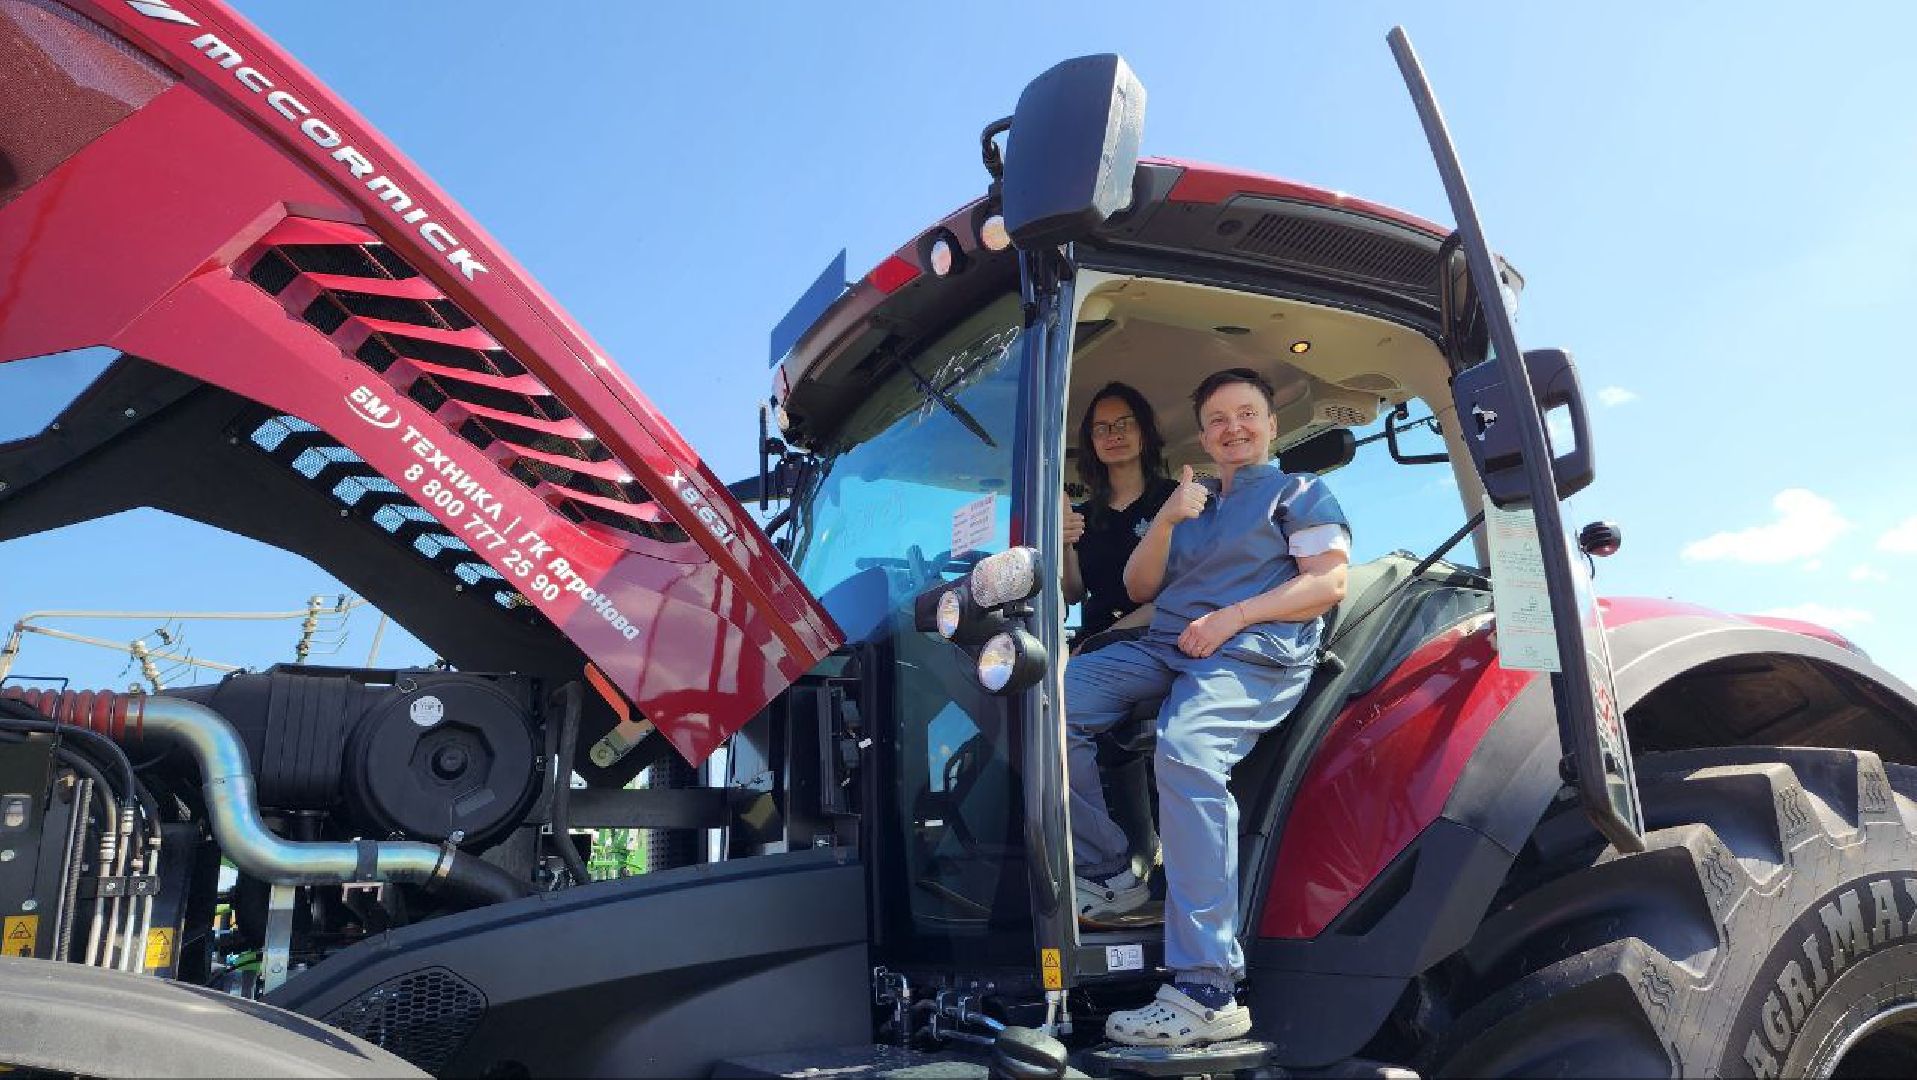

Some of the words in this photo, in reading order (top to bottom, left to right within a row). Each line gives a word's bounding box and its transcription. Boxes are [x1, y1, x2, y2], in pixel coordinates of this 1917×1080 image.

[401, 425, 503, 521] ТЕХНИКА
[518, 531, 553, 559] ГК
[405, 464, 424, 481] 8
[422, 479, 465, 516] 800
[464, 512, 507, 549] 777
[502, 549, 534, 576] 25
[531, 574, 559, 600] 90
